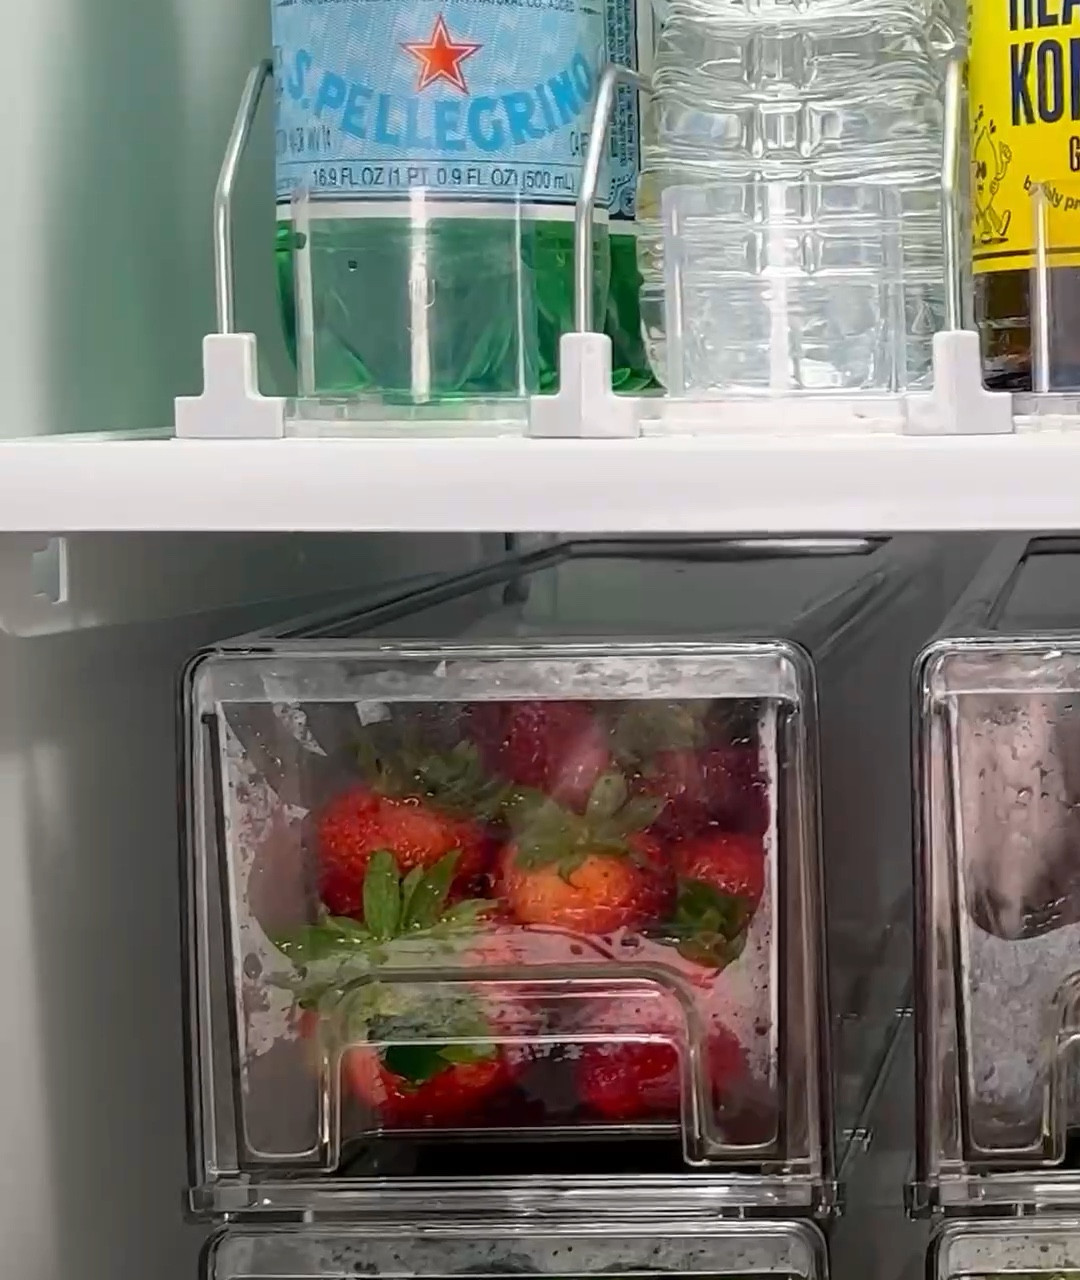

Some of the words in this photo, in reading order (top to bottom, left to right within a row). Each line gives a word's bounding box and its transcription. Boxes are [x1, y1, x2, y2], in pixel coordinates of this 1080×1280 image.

[286, 48, 595, 153] S.PELLEGRINO
[313, 167, 338, 187] 16.9
[341, 168, 358, 185] FL
[362, 167, 385, 185] OZ
[407, 167, 427, 185] PT
[436, 167, 462, 186] 0.9
[467, 168, 488, 186] FL
[522, 169, 552, 192] (500
